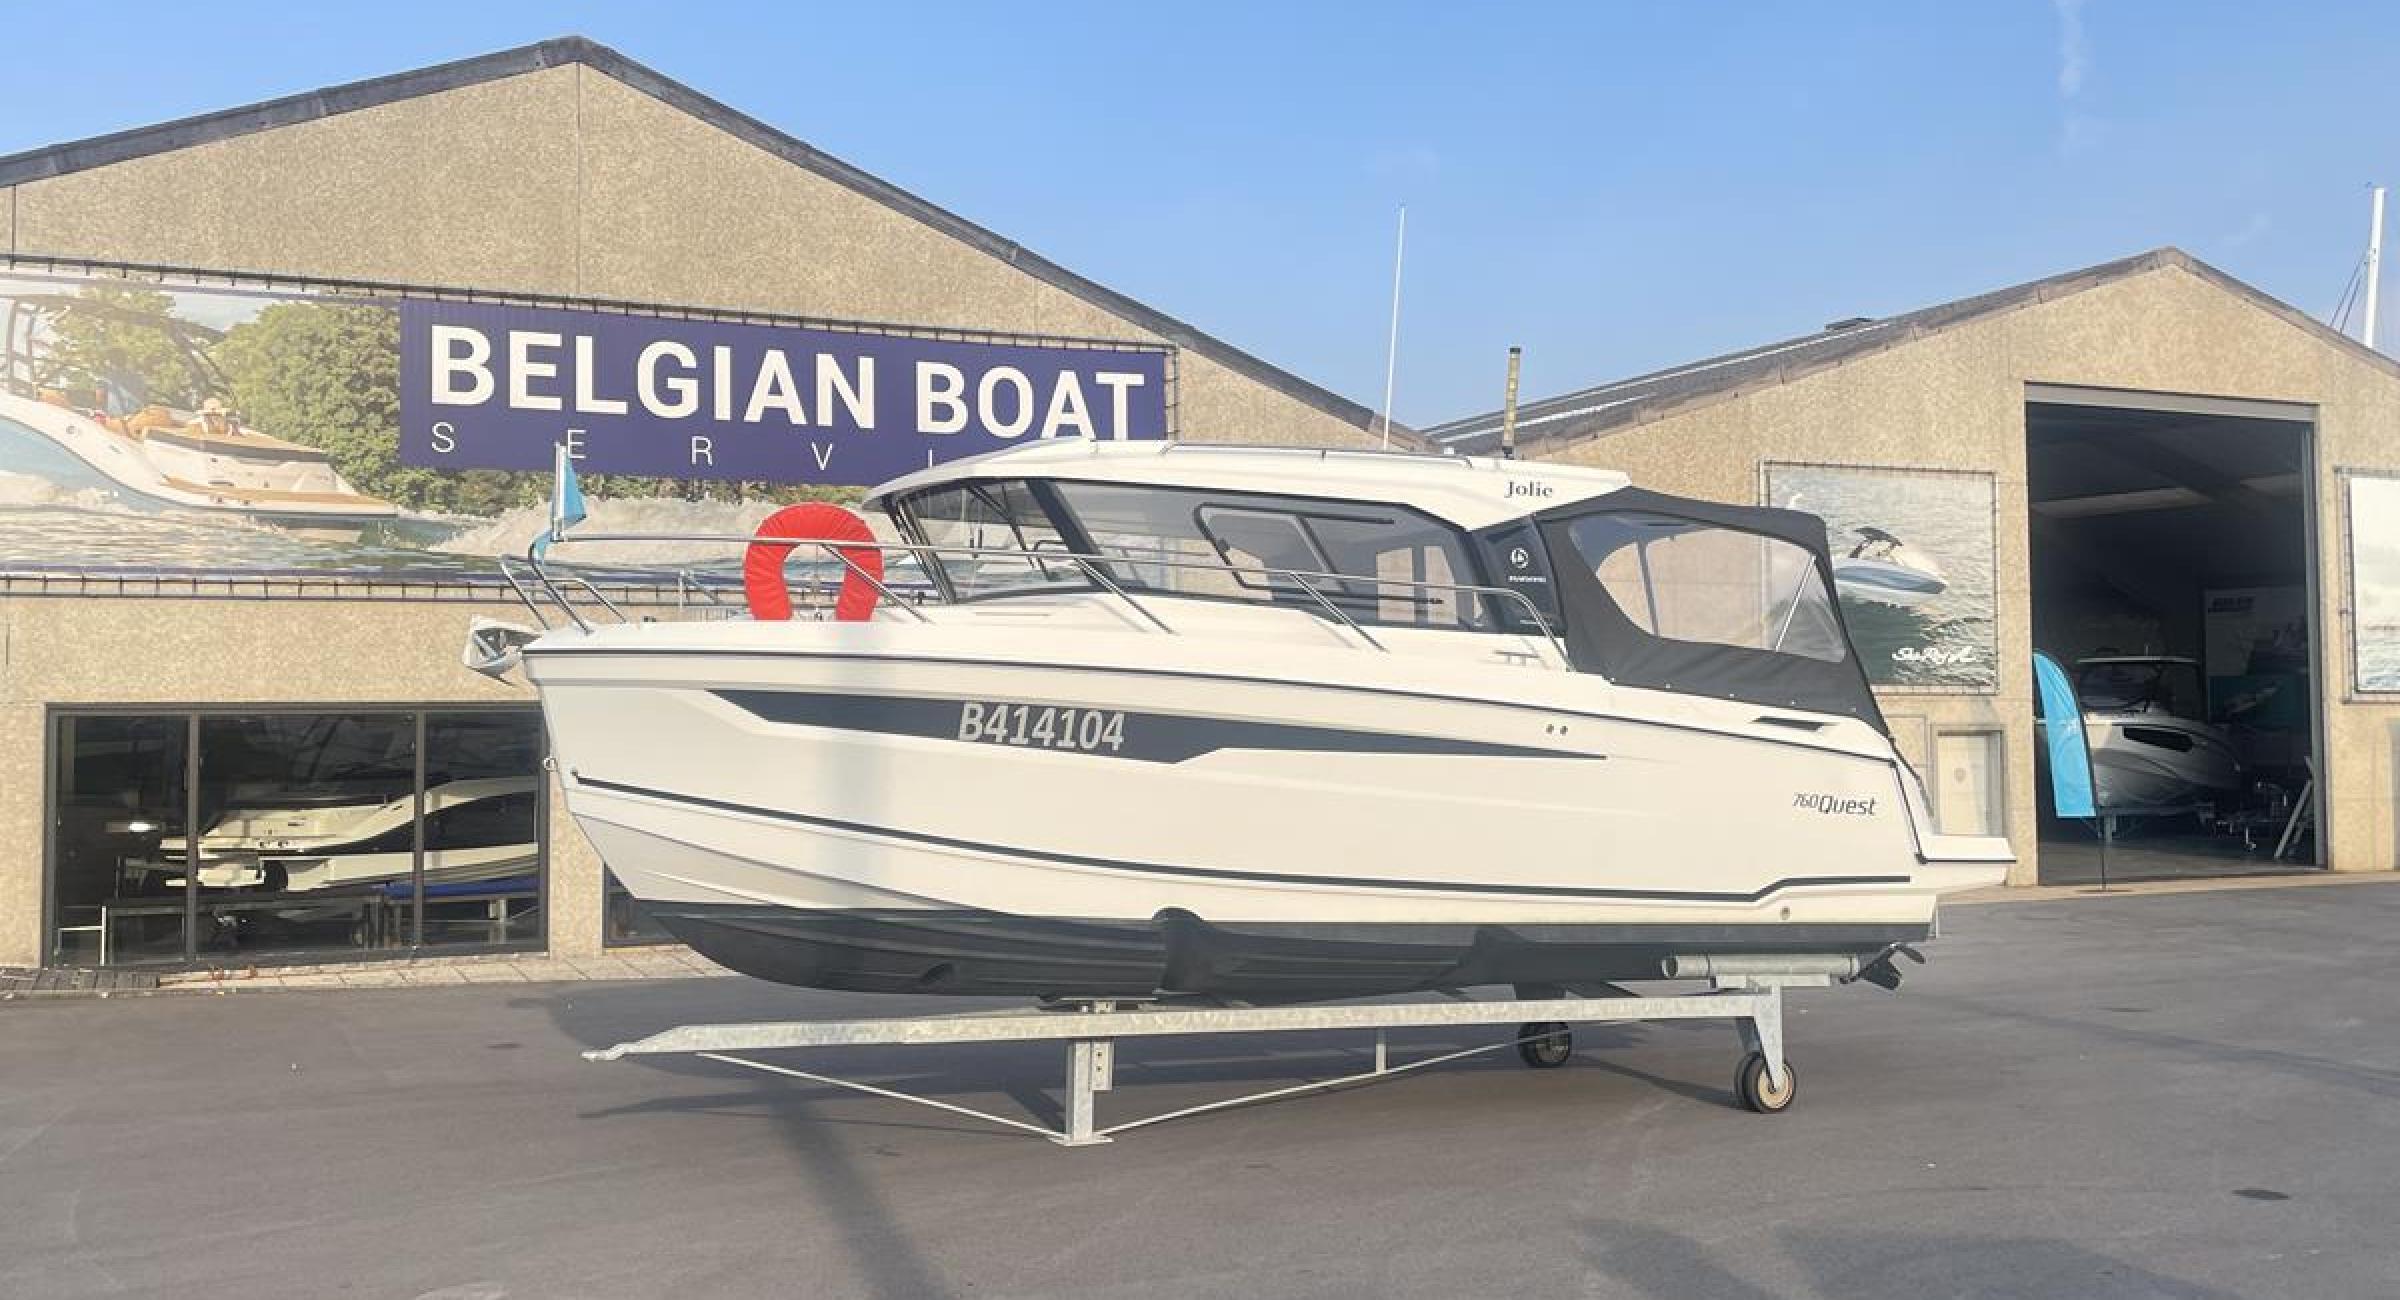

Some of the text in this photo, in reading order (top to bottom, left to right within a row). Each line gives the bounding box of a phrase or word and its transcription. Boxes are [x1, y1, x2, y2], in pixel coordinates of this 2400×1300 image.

[431, 325, 1145, 440] BELGIAN BOAT
[431, 422, 933, 471] SERVI
[1503, 480, 1553, 499] Jolie
[958, 703, 1125, 751] B414104
